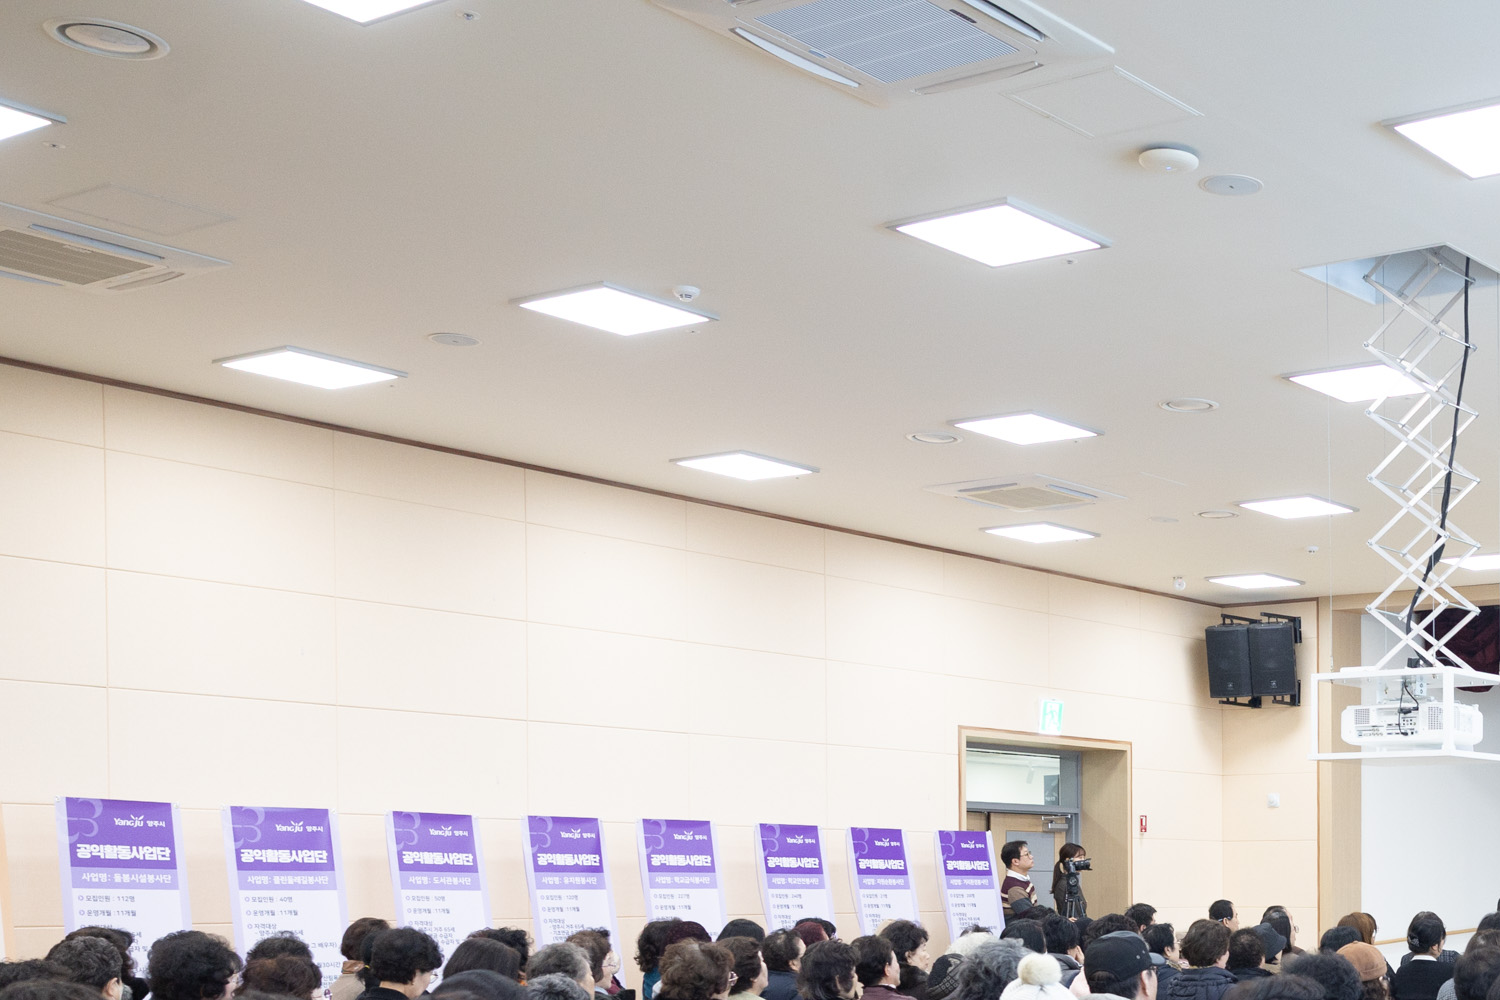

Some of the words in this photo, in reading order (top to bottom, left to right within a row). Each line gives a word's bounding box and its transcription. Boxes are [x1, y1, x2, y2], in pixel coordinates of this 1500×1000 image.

[76, 844, 170, 860] 공익활동사업단
[240, 849, 328, 864] 공익활동사업단
[402, 851, 474, 866] 공익활동사업단
[537, 854, 600, 866] 공익활동사업단
[82, 872, 110, 882] 사업명:
[114, 873, 172, 884] 돌봄시설봉사단
[247, 876, 272, 884] 사업명:
[408, 876, 432, 885] 사업명:
[433, 876, 471, 885] 도서관봉사단
